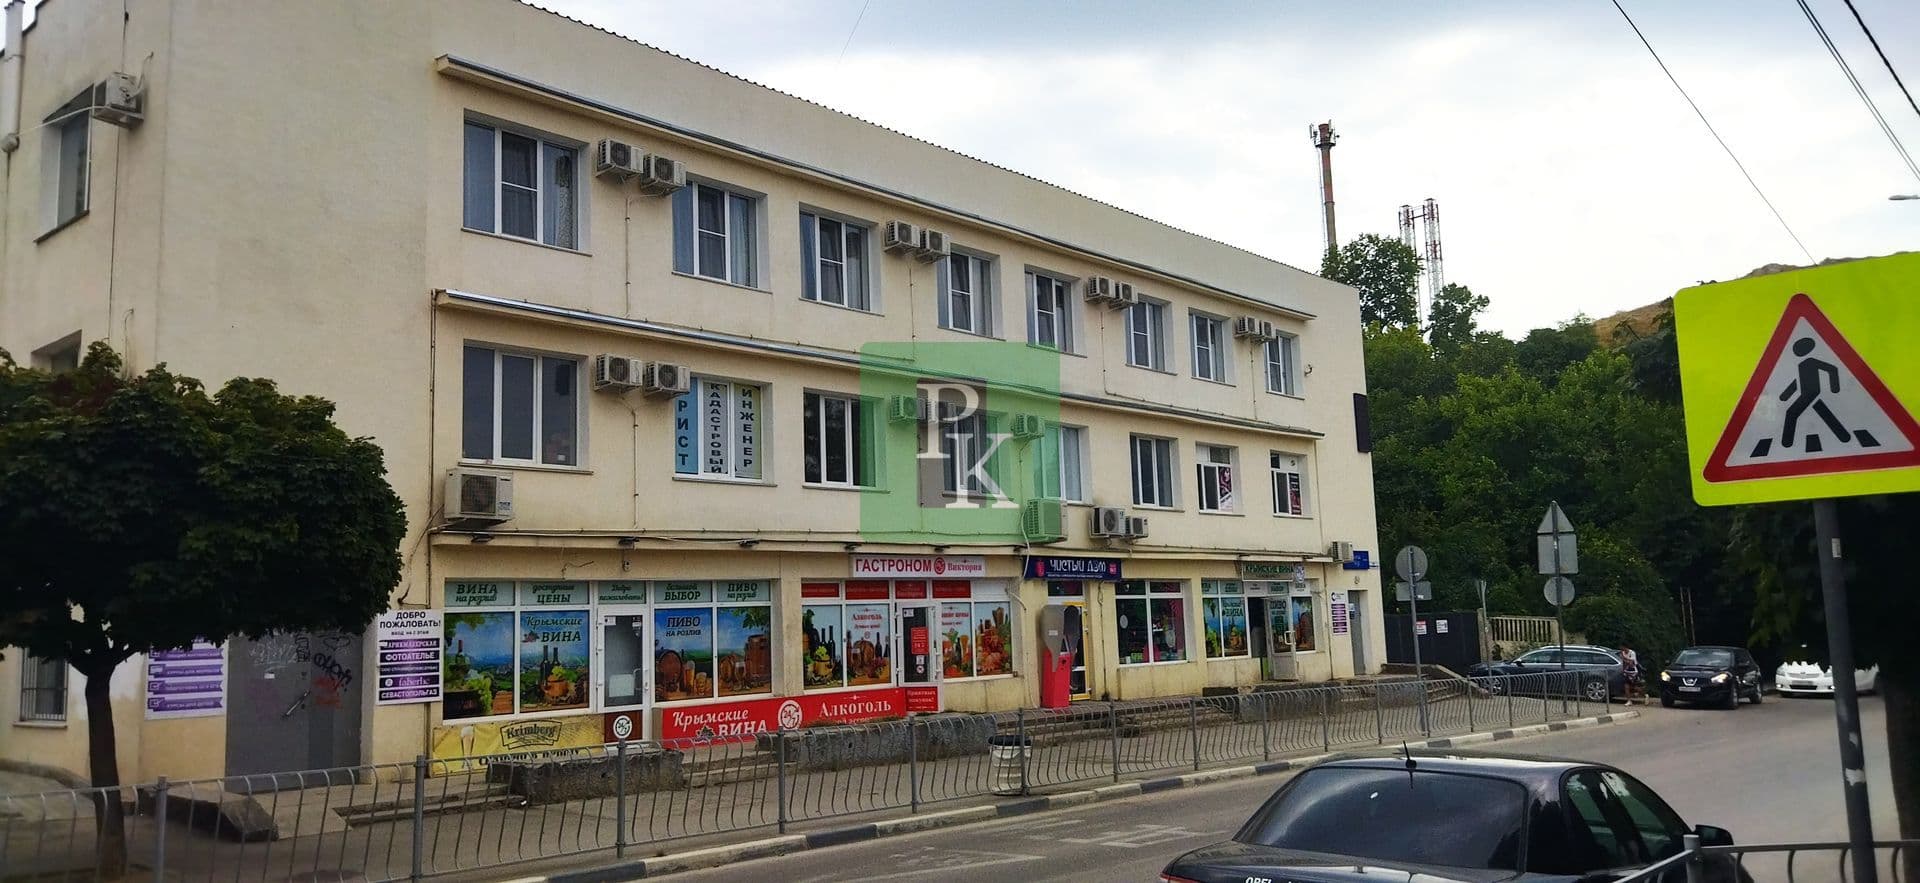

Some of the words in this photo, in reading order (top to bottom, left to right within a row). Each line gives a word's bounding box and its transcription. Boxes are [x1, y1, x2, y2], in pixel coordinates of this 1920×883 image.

[677, 400, 689, 466] РИСТ
[740, 388, 755, 467] ИНЖЕНЕР
[855, 559, 932, 572] ГАСТРОНОМ
[948, 562, 983, 571] Виктория
[456, 584, 498, 594] ВИНА
[727, 583, 758, 592] ПИВО
[537, 594, 571, 604] ЦЕНЫ
[664, 591, 701, 601] ВЫБОР
[395, 611, 426, 620] ДОБРО
[526, 615, 583, 628] Крымские
[380, 620, 441, 629] ПОЖАЛОВАТЬ!
[666, 616, 701, 628] ПИВО
[541, 631, 582, 643] ВИНА
[387, 642, 437, 650] АРИКМАХЕРСКАЯ
[385, 652, 435, 661] ФОТОАТЕЛЬЕ
[381, 688, 437, 699] СЕВАСТОПОЛЬГАЗ
[819, 698, 892, 718] Алкоголь
[673, 709, 749, 732] Крымские
[506, 723, 556, 738] Krimberg
[718, 720, 767, 737] ВИНА
